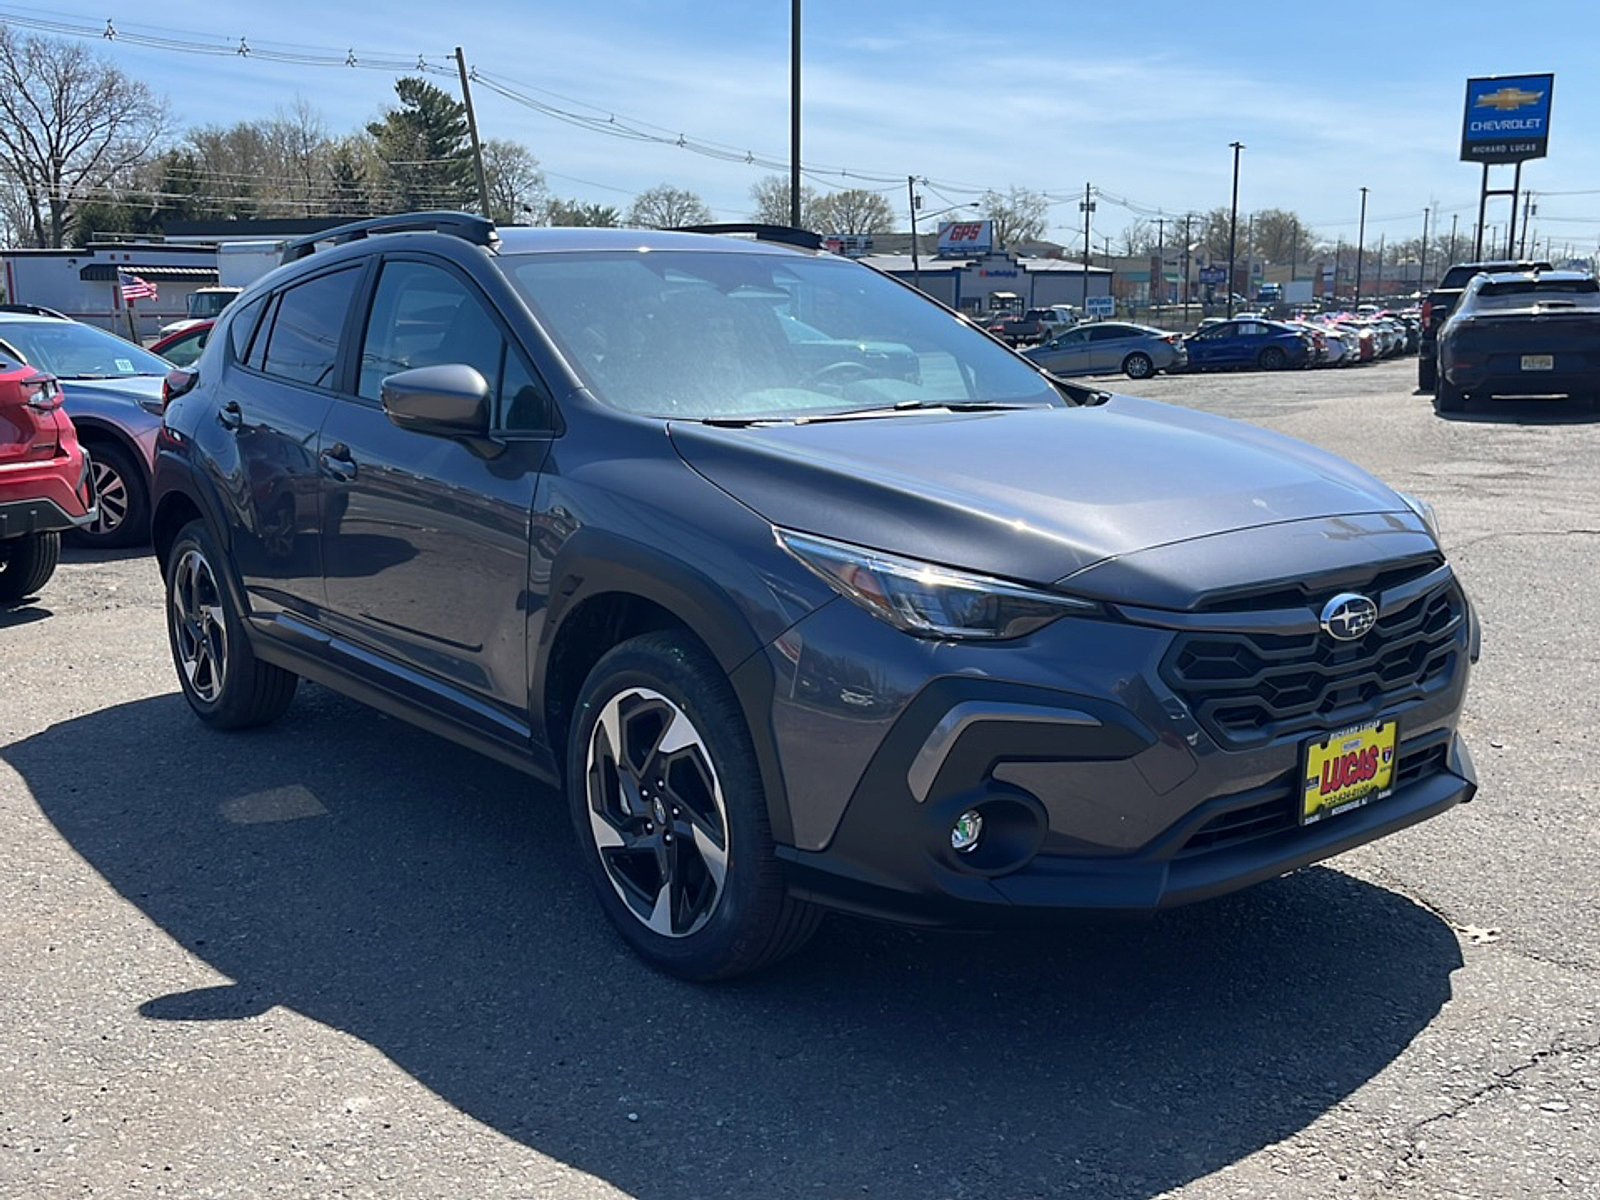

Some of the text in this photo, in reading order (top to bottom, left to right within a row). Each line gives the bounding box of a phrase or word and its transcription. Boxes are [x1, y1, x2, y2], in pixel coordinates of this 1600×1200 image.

[1470, 118, 1542, 131] CHEVROLET
[1472, 143, 1537, 153] RICHARD LUCAS
[949, 224, 982, 241] GPS
[1320, 745, 1379, 796] LUCAS
